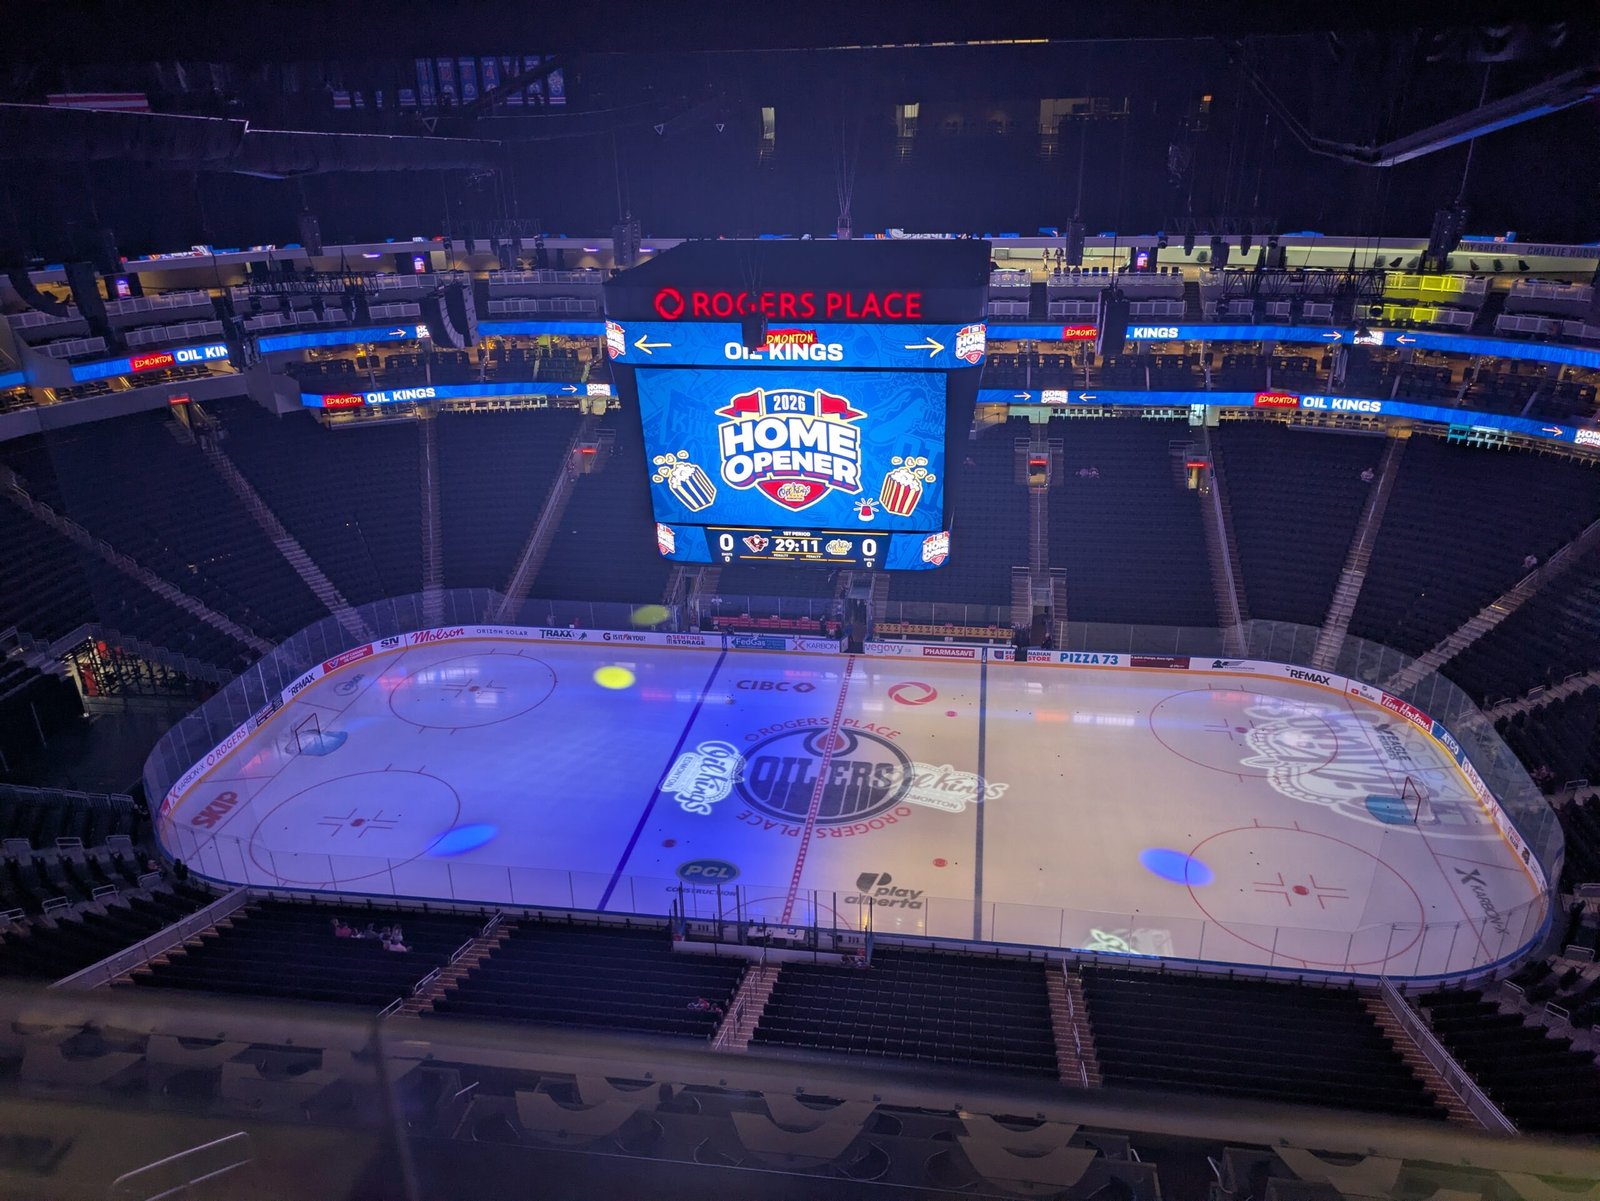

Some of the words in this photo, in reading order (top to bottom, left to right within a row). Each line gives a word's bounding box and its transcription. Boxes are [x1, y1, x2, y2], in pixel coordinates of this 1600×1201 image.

[692, 291, 815, 317] ROGERS
[825, 292, 922, 318] PLACE
[765, 334, 814, 344] DMONTON
[1133, 327, 1179, 339] KINGS
[134, 354, 173, 368] EDMONTON
[177, 349, 202, 362] OIL
[205, 345, 228, 358] KIN
[769, 343, 844, 361] KINGS
[326, 396, 362, 405] EDMONTON
[367, 393, 391, 404] OIL
[392, 387, 436, 401] KINGS
[773, 395, 806, 411] 2026
[1258, 395, 1297, 404] EDMONTON
[1302, 397, 1327, 408] OIL
[1331, 400, 1381, 413] KINGS
[723, 418, 857, 460] HOME
[1577, 430, 1600, 439] HOM
[725, 450, 857, 485] OPENER
[719, 534, 734, 551] 0
[775, 539, 819, 552] 29:11
[862, 539, 877, 556] 0
[381, 637, 399, 647] SN
[411, 628, 464, 643] Molson
[539, 629, 572, 638] TRAXX
[736, 637, 766, 647] FedGas
[924, 648, 975, 657] PHARMASAVE
[1060, 652, 1099, 664] PIZZA
[1103, 654, 1119, 665] 73
[291, 672, 316, 696] REMAX
[736, 680, 789, 691] CIBC
[1290, 669, 1331, 686] REMAX
[1381, 694, 1400, 712] Tim
[1399, 703, 1430, 730] Hortons
[759, 717, 830, 737] ROGERS
[842, 718, 901, 739] PLACE
[215, 727, 247, 758] ROGERS
[1441, 732, 1460, 755] ATCO
[750, 755, 893, 809] OILERS
[192, 791, 238, 829] SKIP
[736, 810, 801, 836] PLACE
[816, 814, 898, 839] ROGERS
[685, 865, 729, 878] PCL
[874, 886, 924, 900] play
[844, 895, 924, 910] alberta
